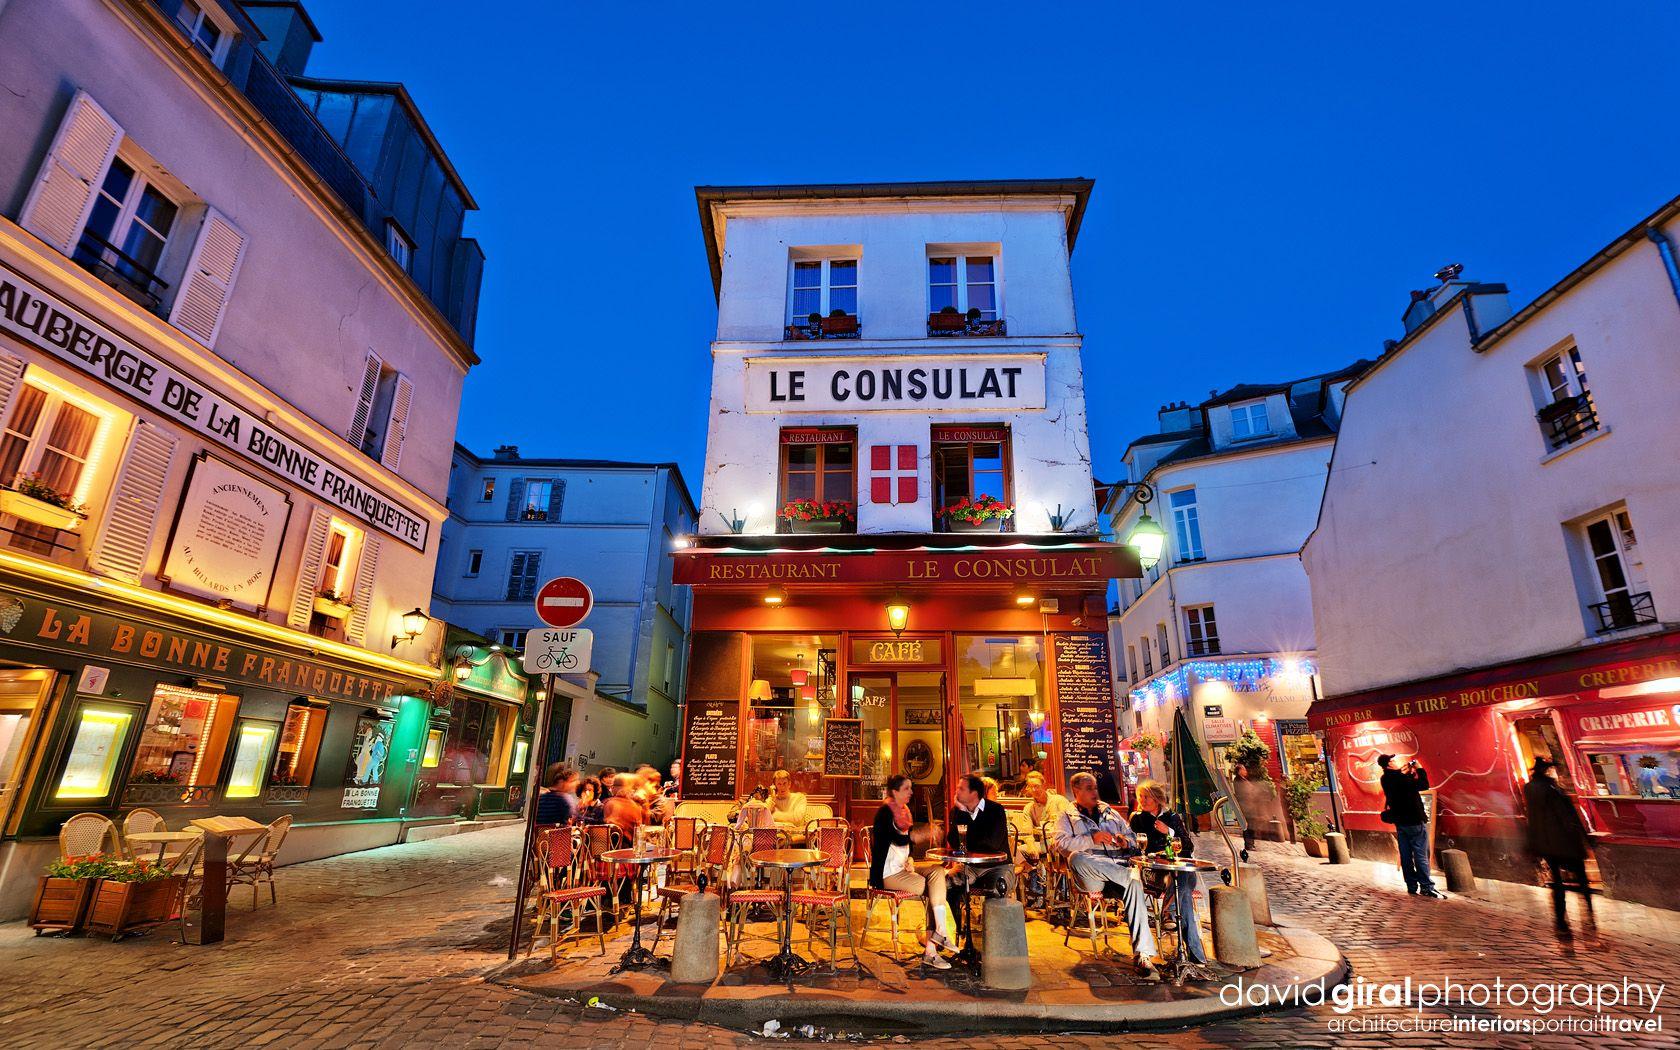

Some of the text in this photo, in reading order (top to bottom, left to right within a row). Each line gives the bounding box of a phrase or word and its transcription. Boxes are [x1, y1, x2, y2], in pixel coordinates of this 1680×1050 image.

[769, 367, 1022, 401] LE CONSULAT
[0, 280, 158, 396] AUBERGE
[161, 376, 203, 422] DE
[207, 403, 240, 444] LA
[248, 429, 320, 484] BONNE
[321, 470, 421, 543] FRANQUETTE
[788, 432, 844, 443] RESTAURANT
[939, 431, 999, 441] LE CONSULAT
[212, 484, 270, 517] ANCIENNEMENT
[709, 563, 841, 579] RESTAURANT
[907, 557, 1102, 579] LE CONSULAT
[542, 632, 578, 643] SAUF
[37, 607, 395, 703] LA BONNE FRANQUETTE
[871, 640, 922, 661] CAFÉ
[1579, 659, 1679, 688] CREPERIE
[1395, 702, 1412, 717] LE
[1415, 696, 1449, 713] TIRE
[1459, 681, 1540, 707] BOUCHON
[1325, 709, 1374, 727] PIANO BAR
[1579, 708, 1671, 732] CREPERIE
